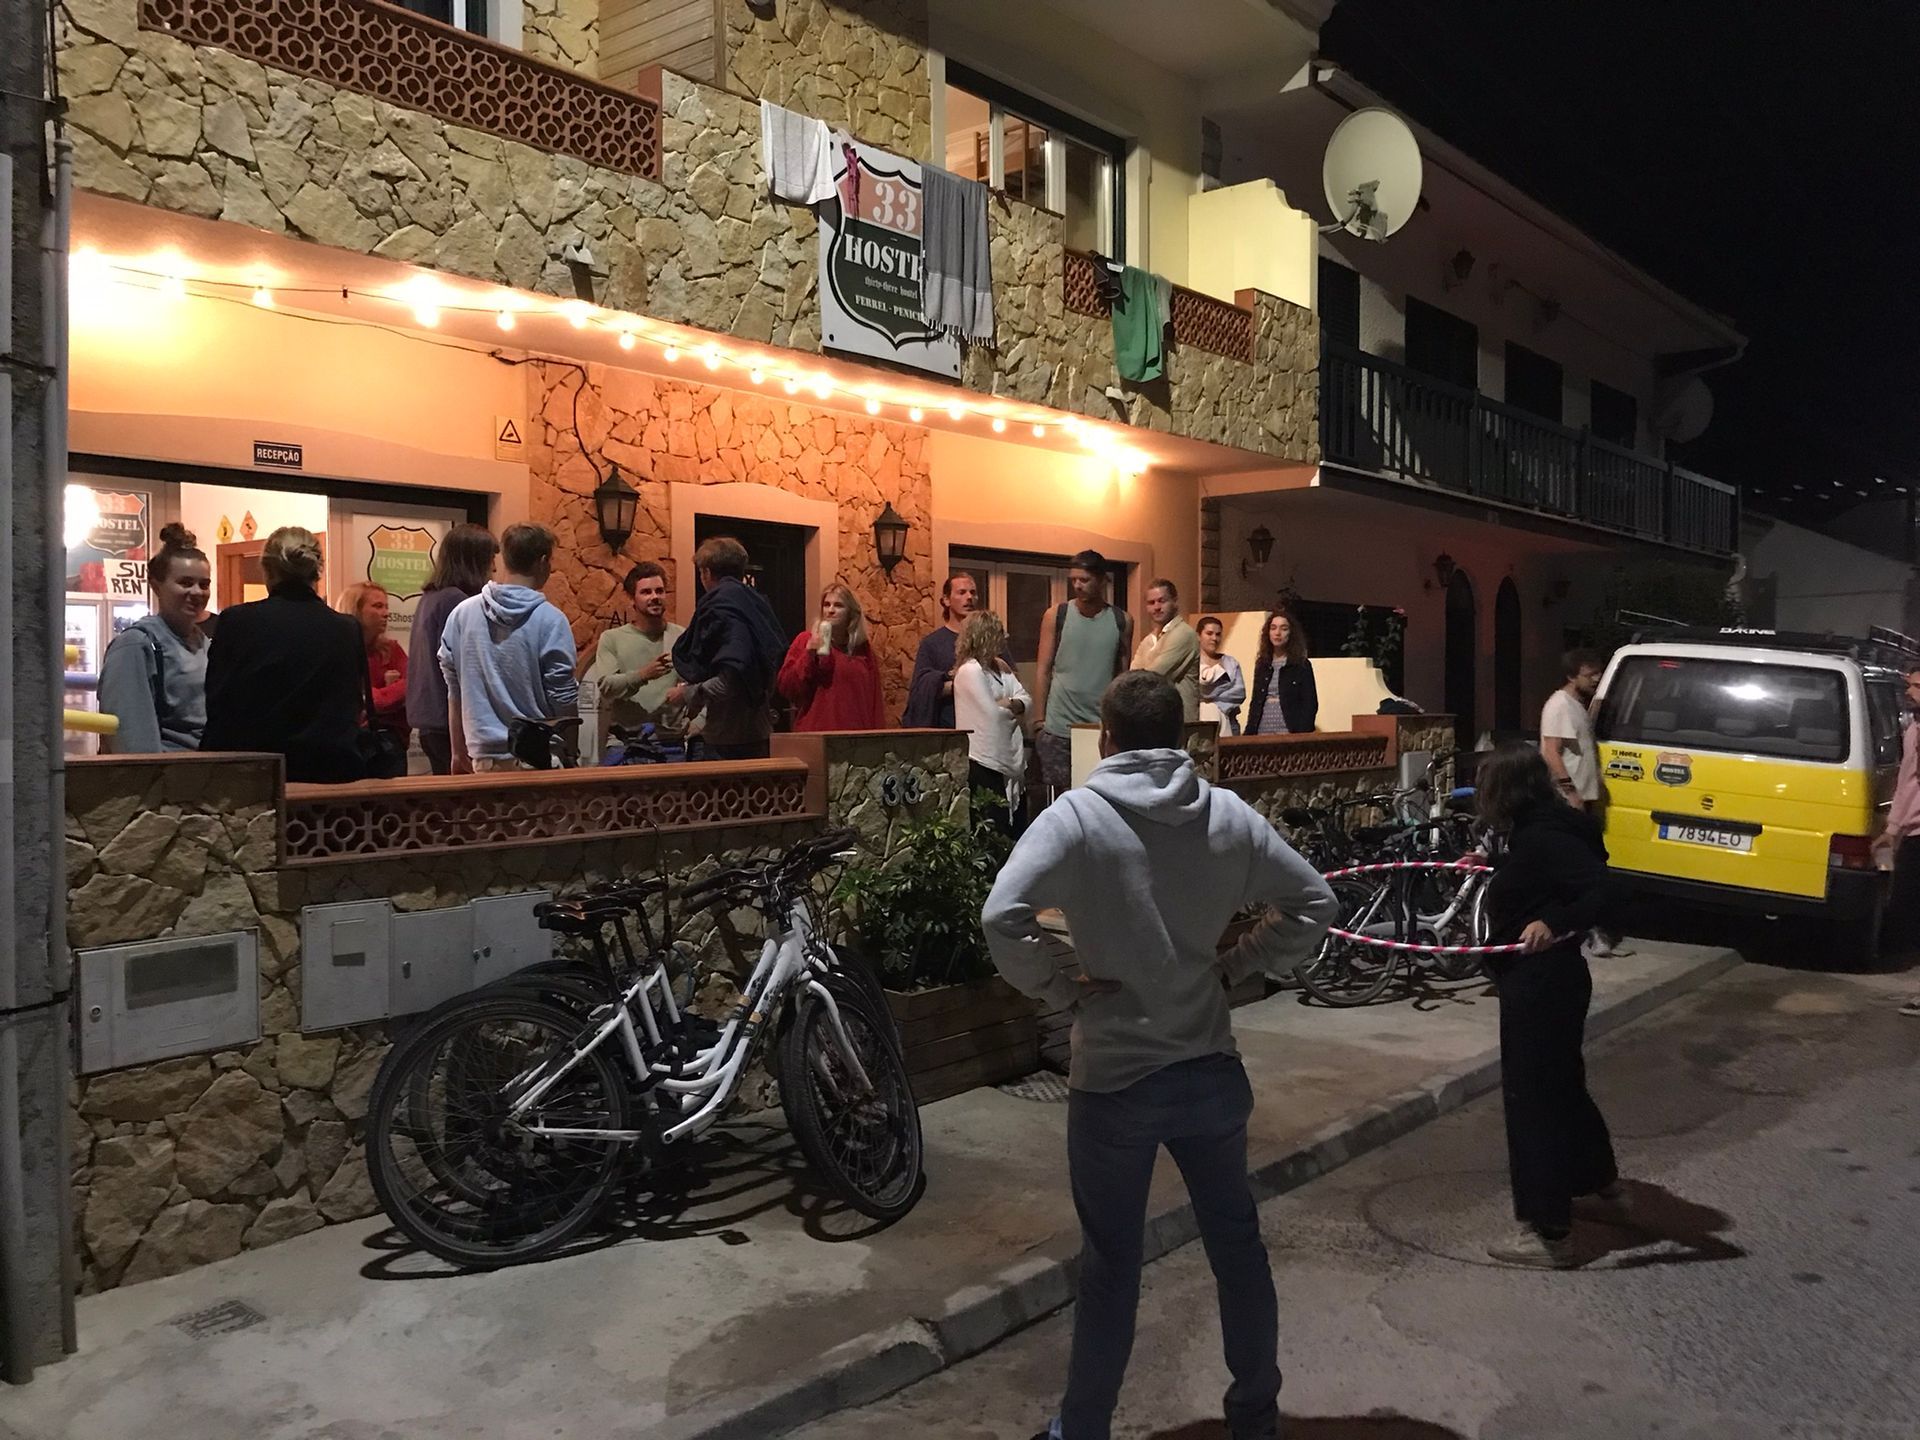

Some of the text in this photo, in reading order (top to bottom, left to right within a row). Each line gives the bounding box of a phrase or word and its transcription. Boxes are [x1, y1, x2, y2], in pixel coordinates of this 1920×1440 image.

[873, 182, 917, 231] 33
[855, 294, 888, 312] FERREL
[256, 448, 299, 463] RECEPÇÃO
[92, 517, 140, 531] OSTEL
[390, 533, 415, 551] 33
[376, 556, 430, 572] HOSTEL
[884, 774, 920, 806] 33
